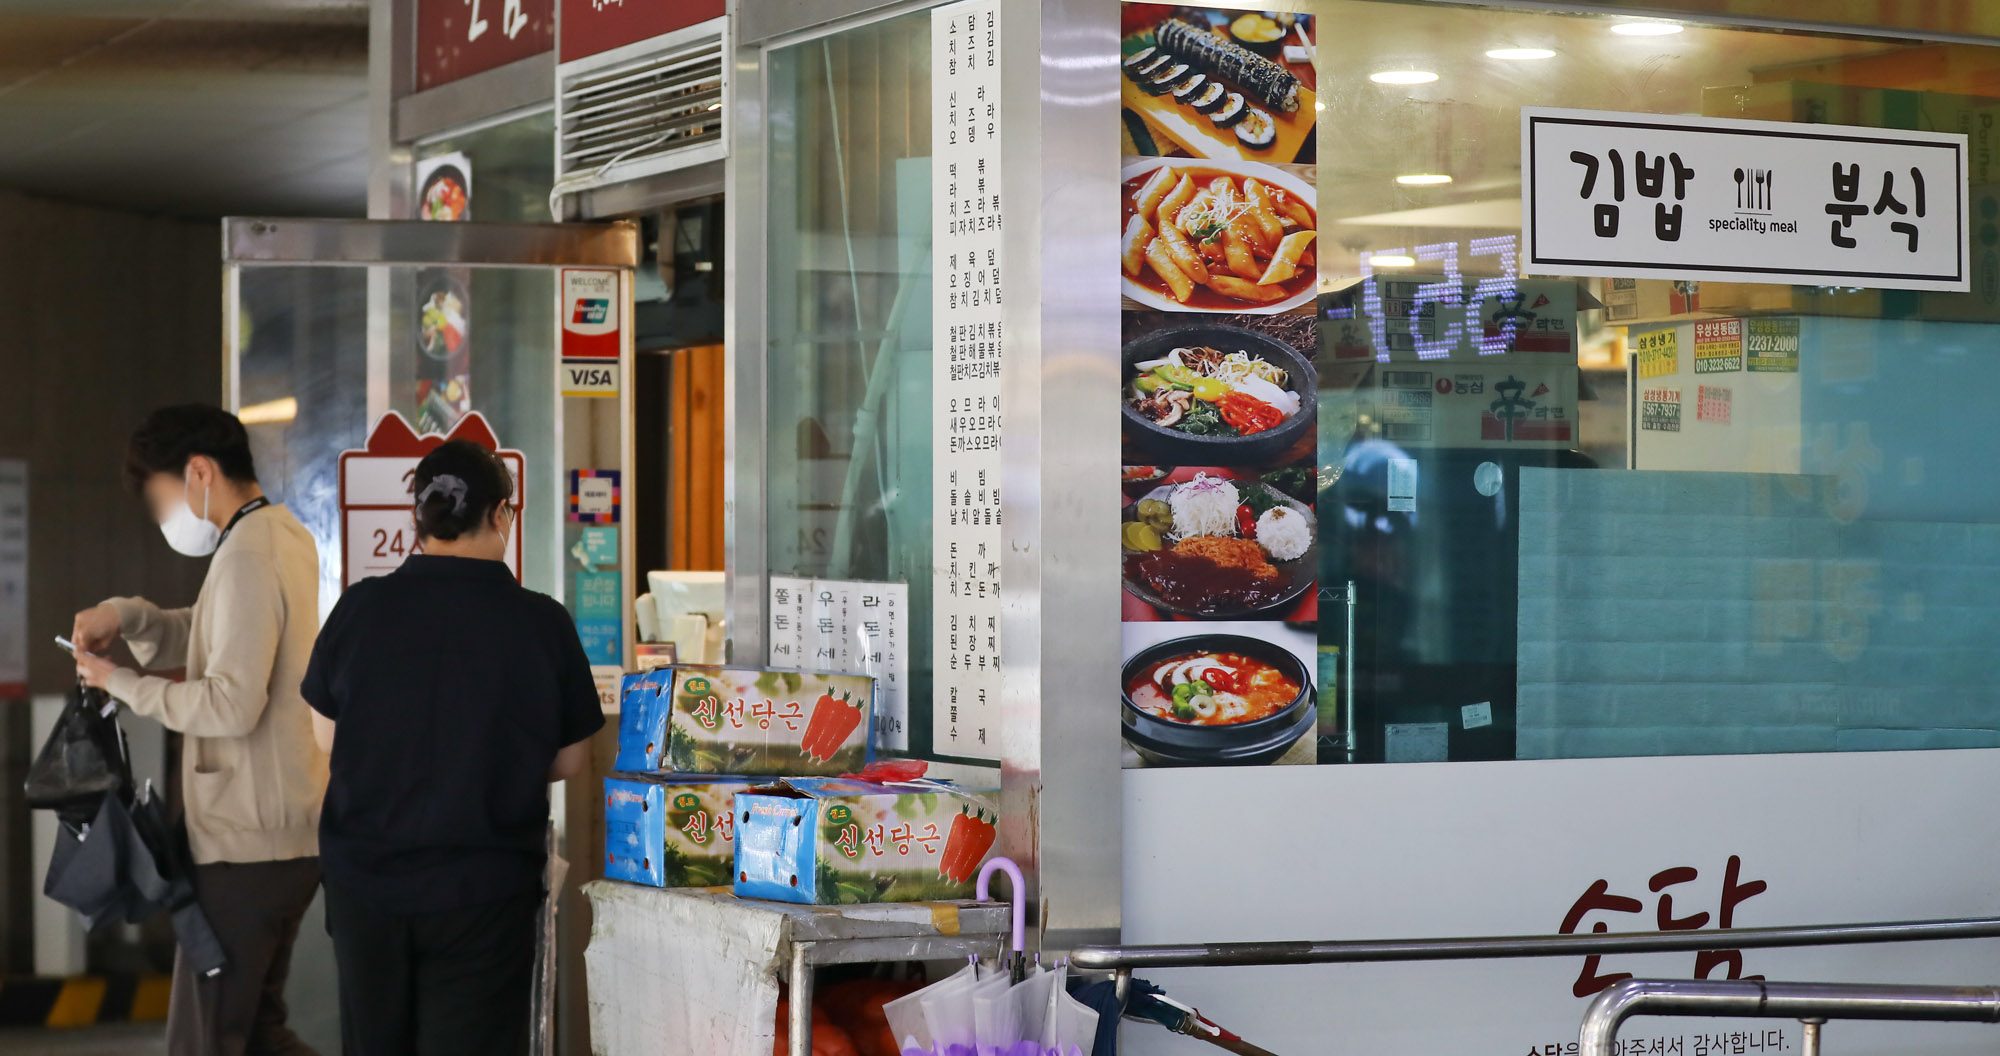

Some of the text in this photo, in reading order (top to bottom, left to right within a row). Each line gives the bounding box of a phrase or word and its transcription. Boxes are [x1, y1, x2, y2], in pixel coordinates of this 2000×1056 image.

[1570, 149, 1926, 253] 김밥 분식
[1709, 217, 1797, 234] speciality meal
[571, 277, 610, 286] WELCOME
[1536, 318, 1565, 332] 라면
[1696, 322, 1728, 338] 우성냉동
[569, 369, 612, 385] VISA
[1454, 381, 1484, 395] 농심
[1535, 406, 1565, 421] 라면
[950, 433, 1001, 453] 돈까스오므라
[692, 697, 804, 732] 신선당근
[682, 811, 734, 843] 신선
[834, 823, 941, 858] 신선당근
[1693, 1029, 1790, 1056] 감사합니다.
